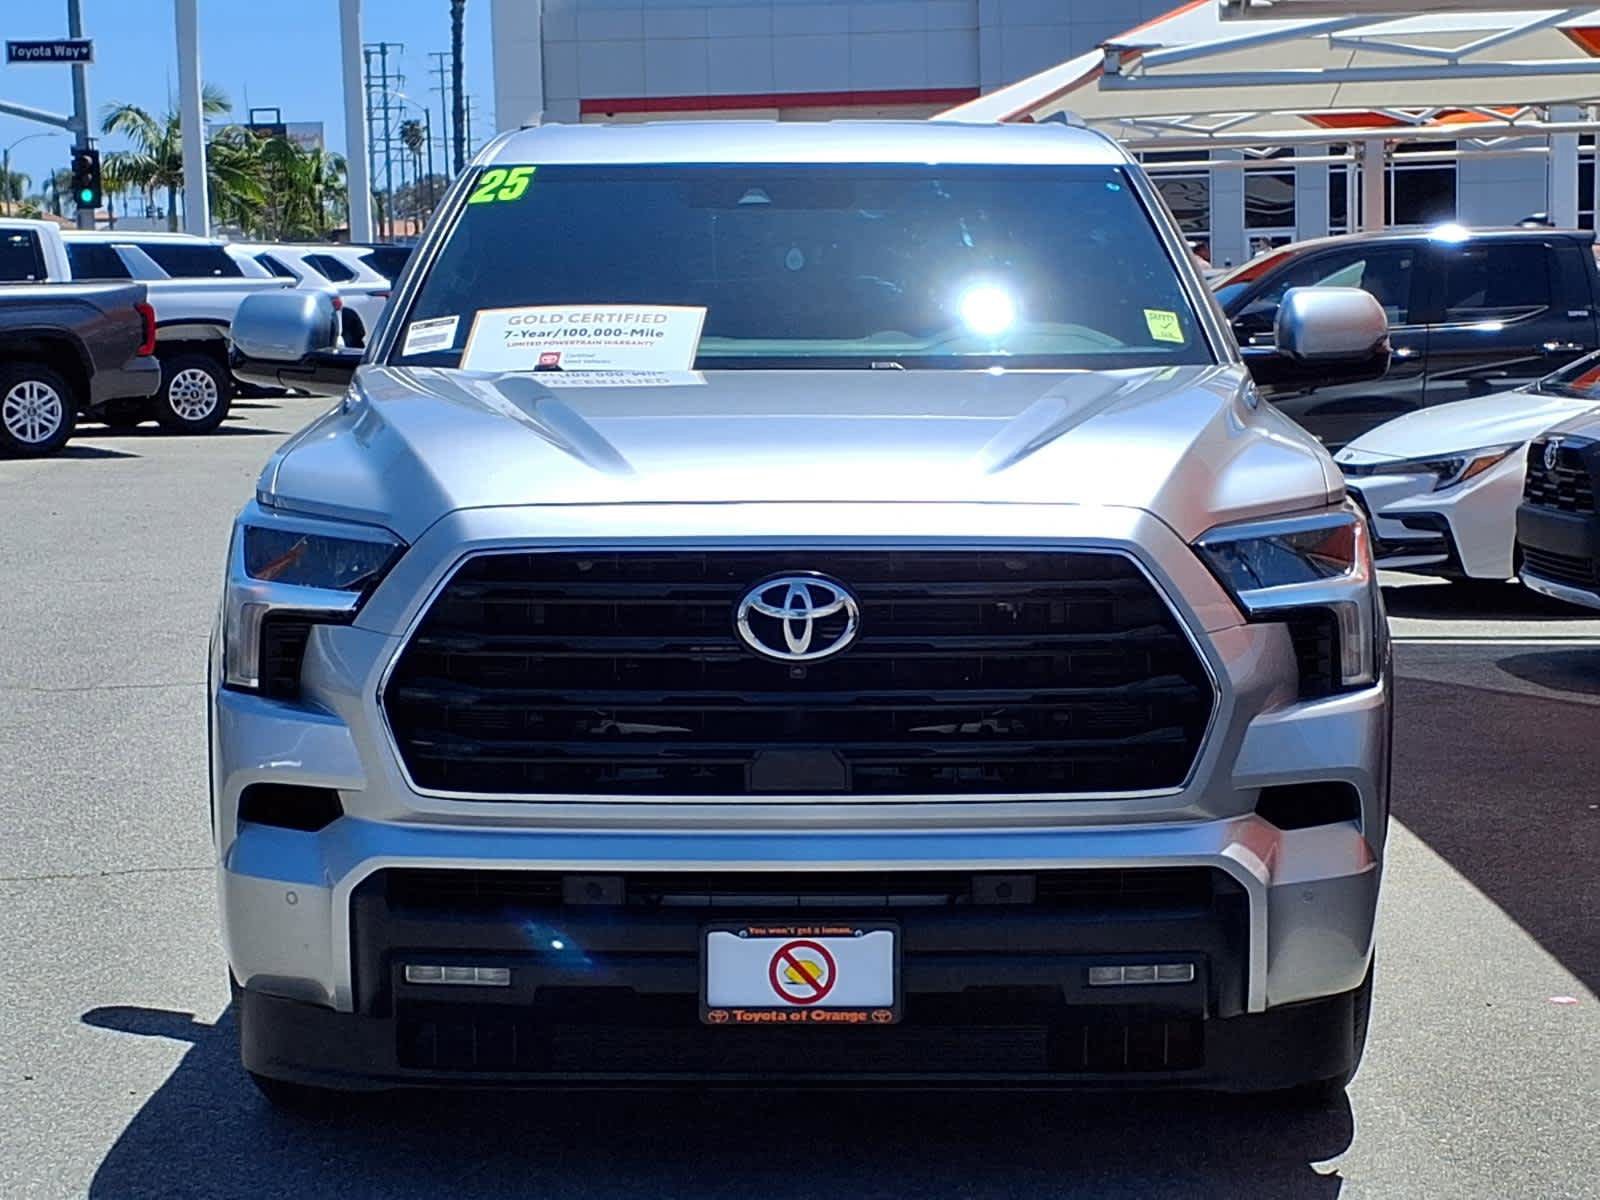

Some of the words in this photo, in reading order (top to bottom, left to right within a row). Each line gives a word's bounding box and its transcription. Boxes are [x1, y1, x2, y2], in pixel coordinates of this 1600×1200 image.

[11, 45, 52, 59] Toyota
[54, 45, 80, 58] Way
[467, 166, 537, 204] 25
[507, 313, 564, 326] GOLD
[567, 312, 668, 324] CERTIFIED
[504, 328, 664, 339] 7-Year/100,000-Mile
[732, 1010, 787, 1022] Toyota
[790, 1010, 807, 1022] of
[811, 1009, 868, 1023] Orange
